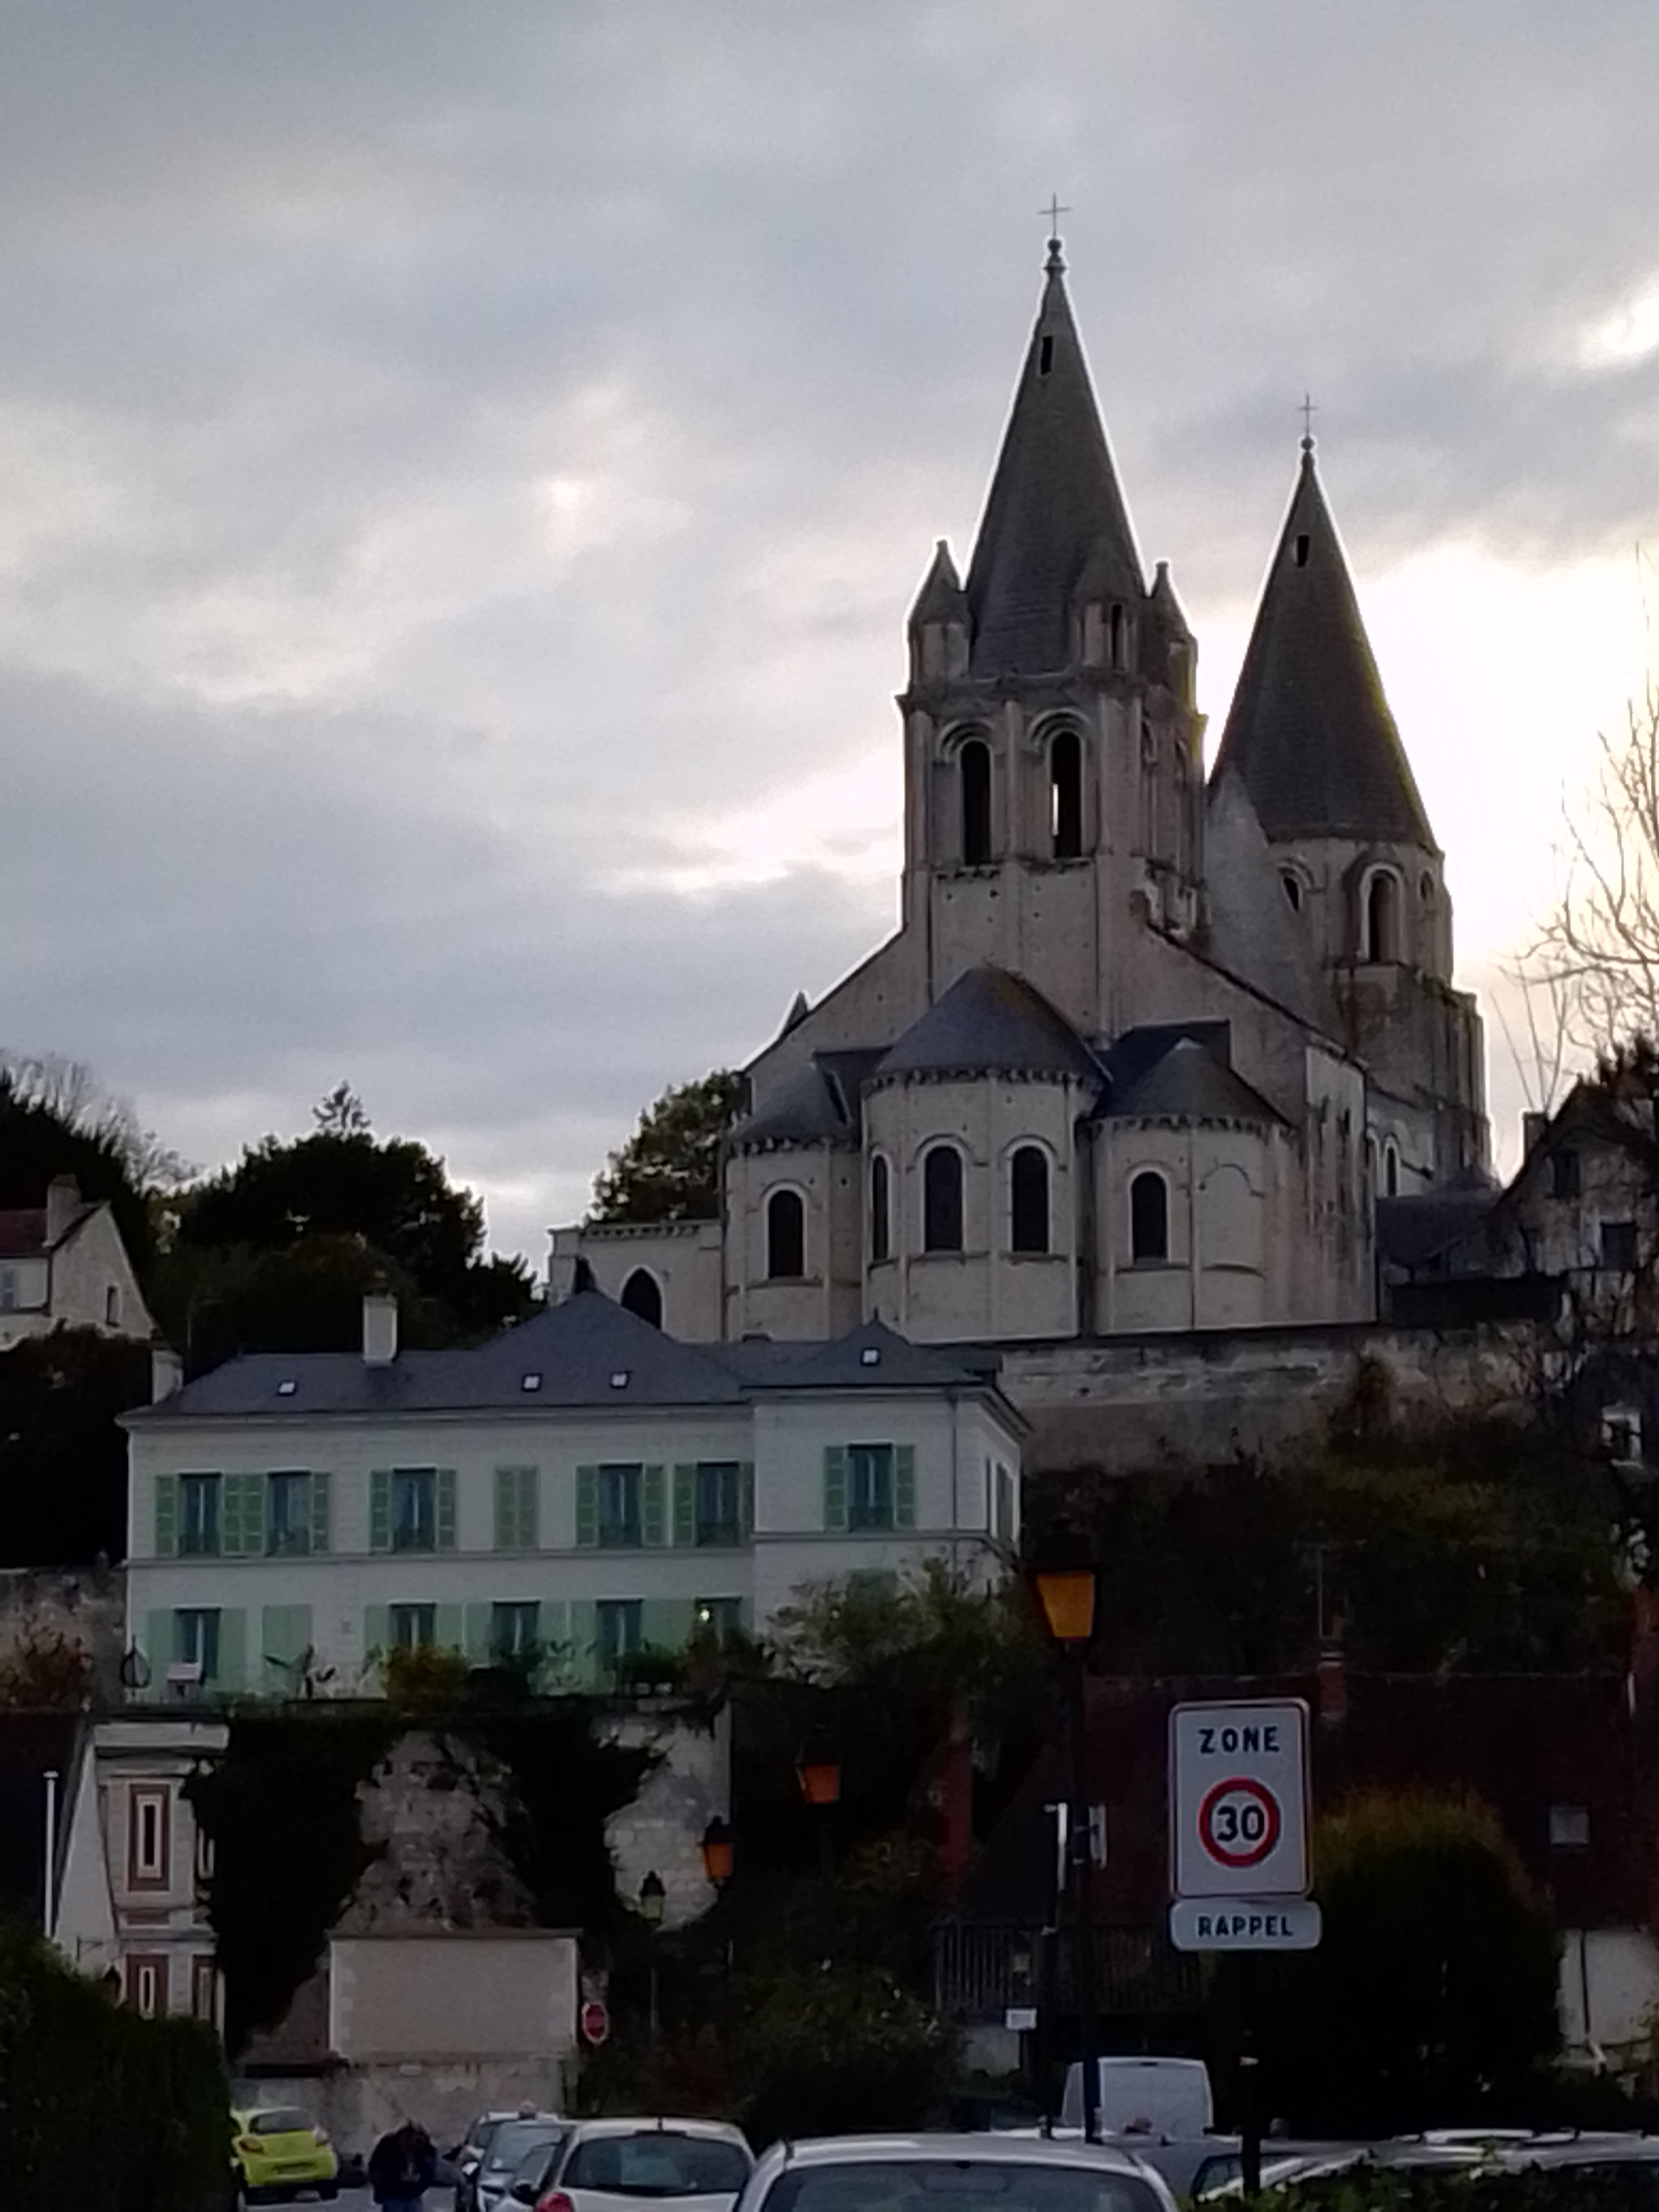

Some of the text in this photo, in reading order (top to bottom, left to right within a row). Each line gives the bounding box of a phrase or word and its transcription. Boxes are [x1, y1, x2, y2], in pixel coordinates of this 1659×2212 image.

[1199, 1727, 1280, 1753] ZONE
[1217, 1806, 1265, 1841] 30
[1197, 1916, 1294, 1937] RAPPEL
